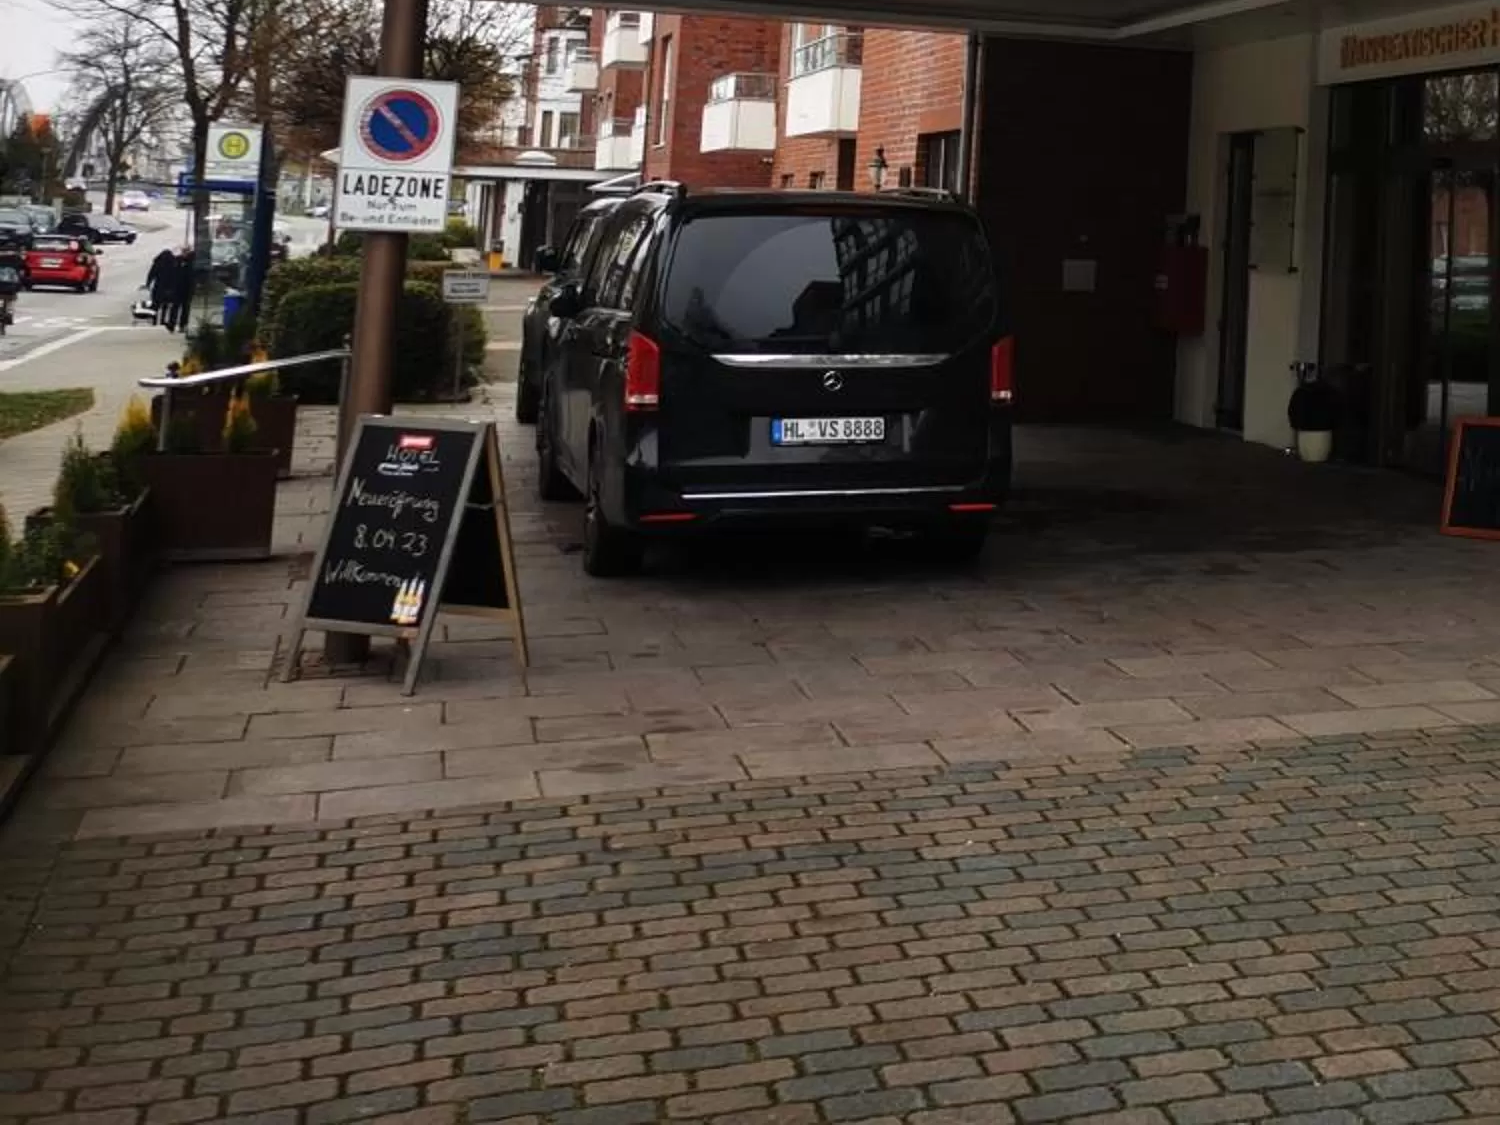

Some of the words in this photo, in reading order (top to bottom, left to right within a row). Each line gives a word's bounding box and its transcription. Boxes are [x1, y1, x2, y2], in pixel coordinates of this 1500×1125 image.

[342, 174, 445, 200] LADEZONE
[784, 422, 805, 439] HL
[818, 420, 839, 438] VS
[843, 420, 883, 438] 8888
